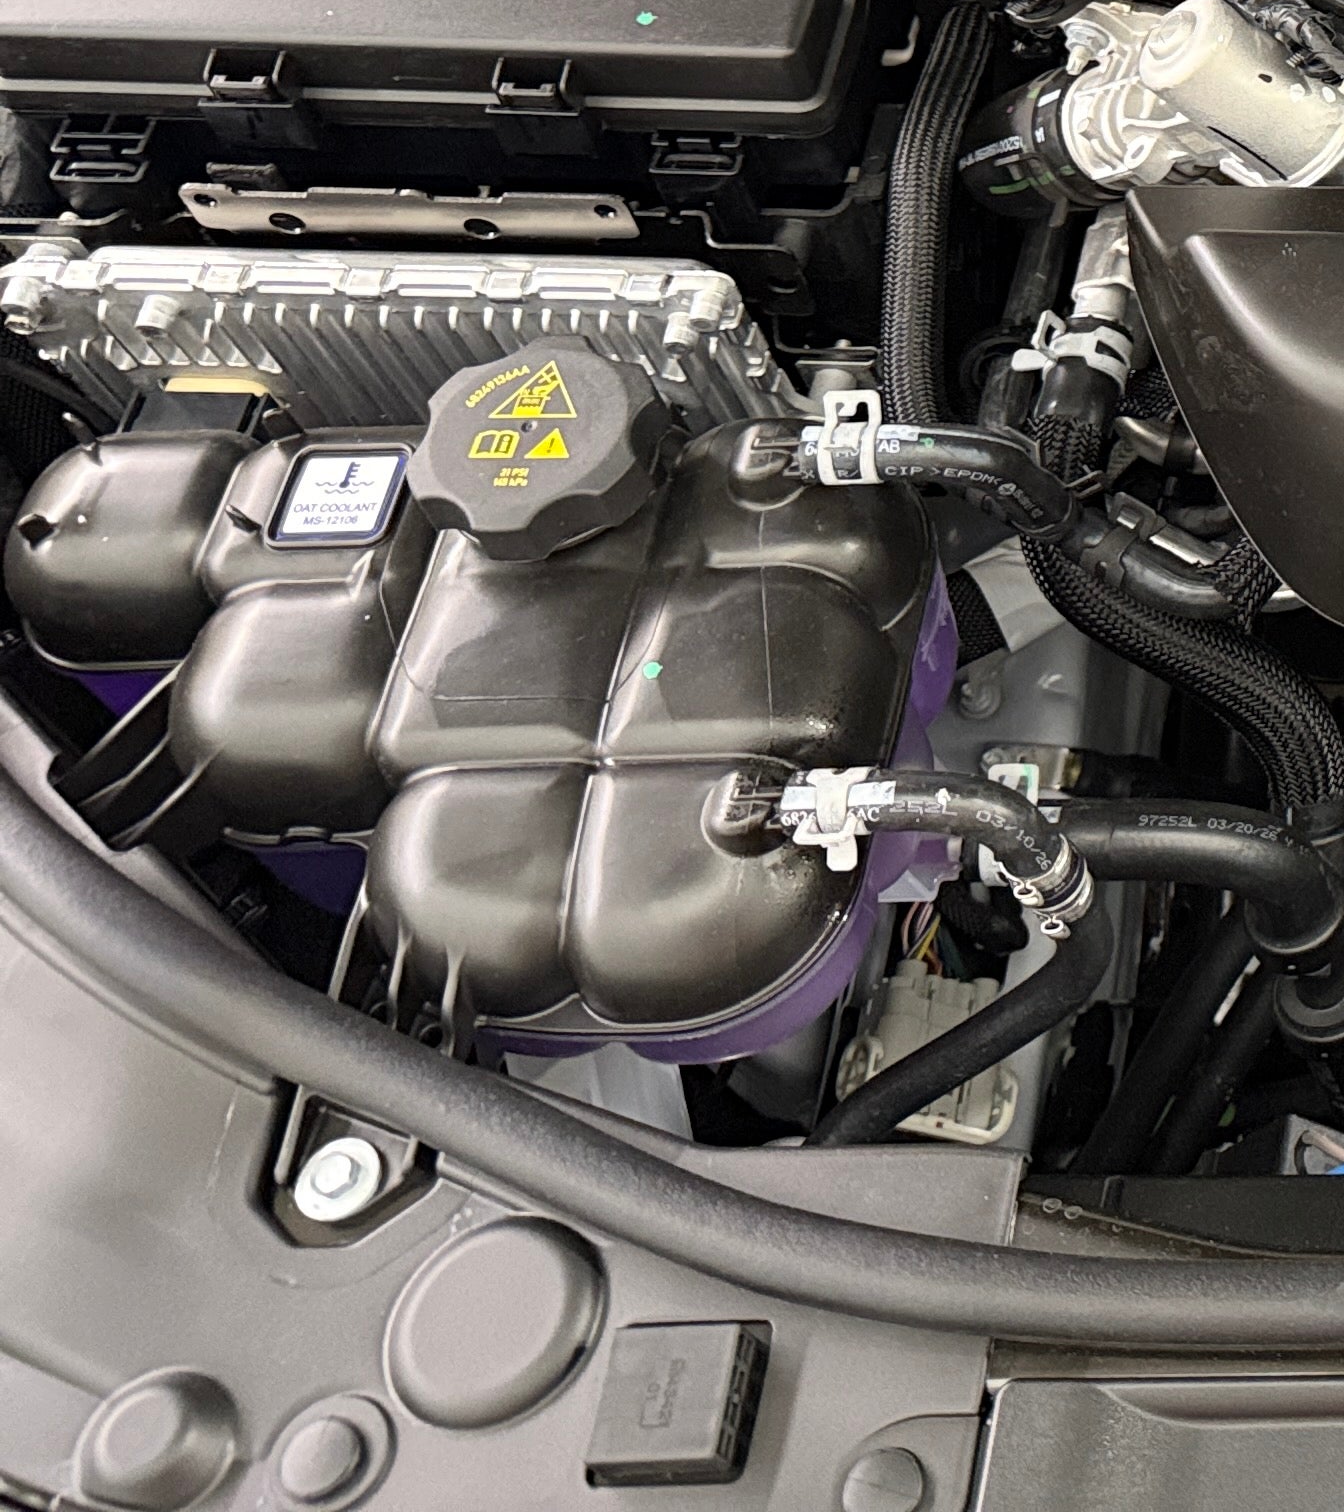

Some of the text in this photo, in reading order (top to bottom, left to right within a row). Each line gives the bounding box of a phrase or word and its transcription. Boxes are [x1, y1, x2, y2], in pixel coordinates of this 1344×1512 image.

[293, 502, 377, 513] OAT COOLANT
[1137, 814, 1198, 828] 97252L
